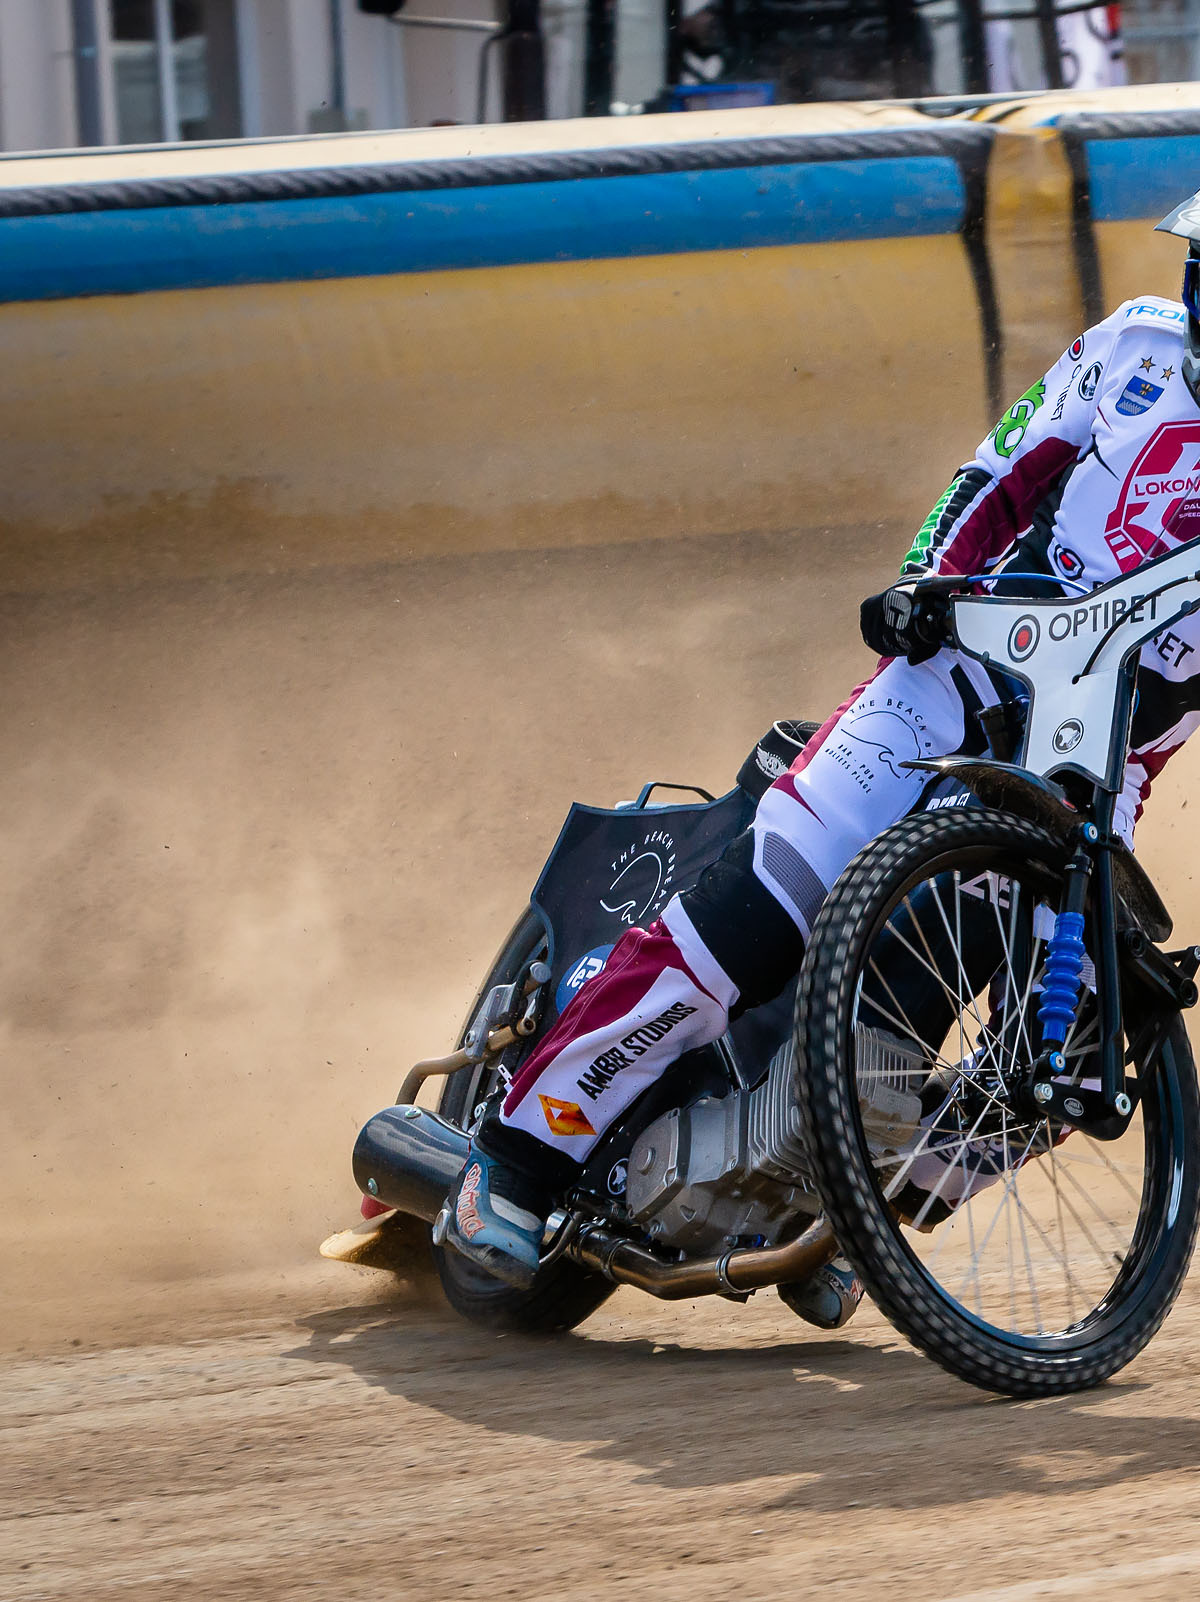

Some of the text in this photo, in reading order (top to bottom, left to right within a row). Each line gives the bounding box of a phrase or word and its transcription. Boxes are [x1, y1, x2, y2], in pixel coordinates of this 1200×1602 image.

[1049, 593, 1162, 641] OPTIBET
[850, 698, 928, 732] THE BEACH
[611, 830, 677, 911] THE BEACH BREAK
[576, 1001, 700, 1101] AMBER STUDIOS
